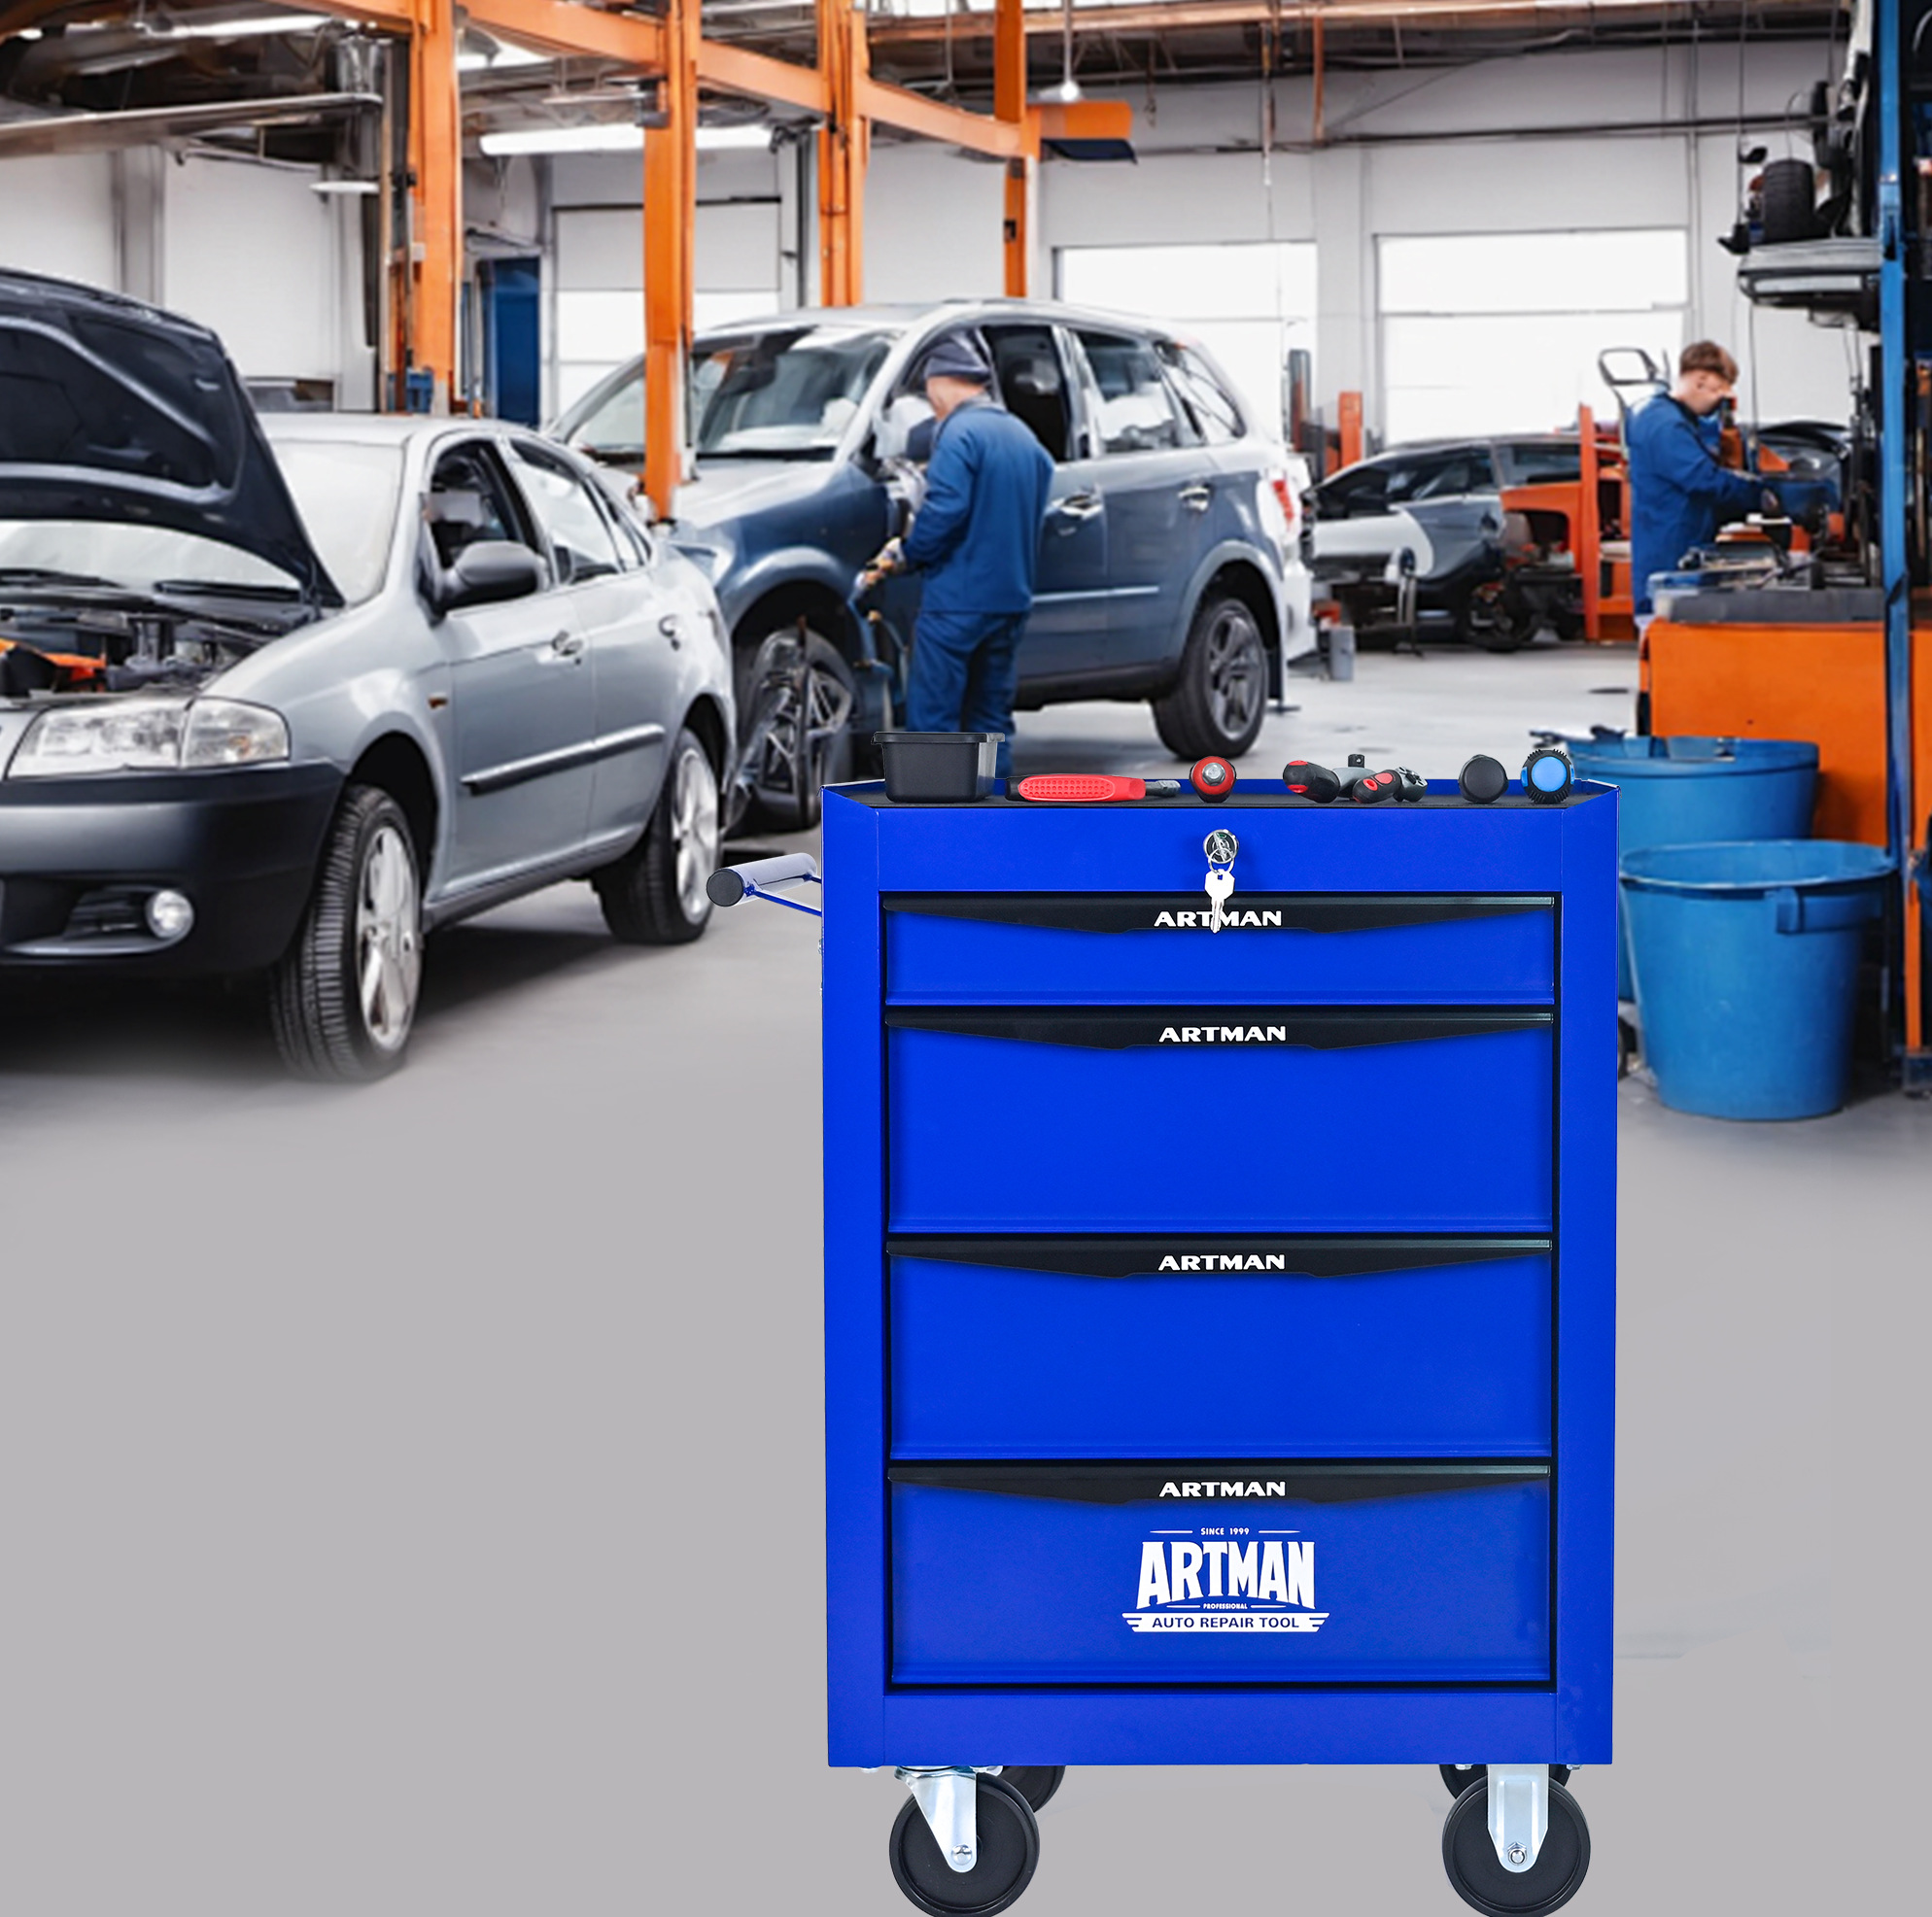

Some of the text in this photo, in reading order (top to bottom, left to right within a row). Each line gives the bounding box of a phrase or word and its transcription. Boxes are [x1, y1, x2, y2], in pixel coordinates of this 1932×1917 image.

[1154, 910, 1282, 927] ARTMAN
[1158, 1025, 1287, 1043] ARTMAN
[1157, 1254, 1286, 1271] ARTMAN
[1158, 1481, 1286, 1497] ARTMAN
[1200, 1527, 1225, 1536] SINCE
[1136, 1540, 1316, 1610] ARTMAN
[1152, 1617, 1299, 1628] AUTO REPAIR TOOL
